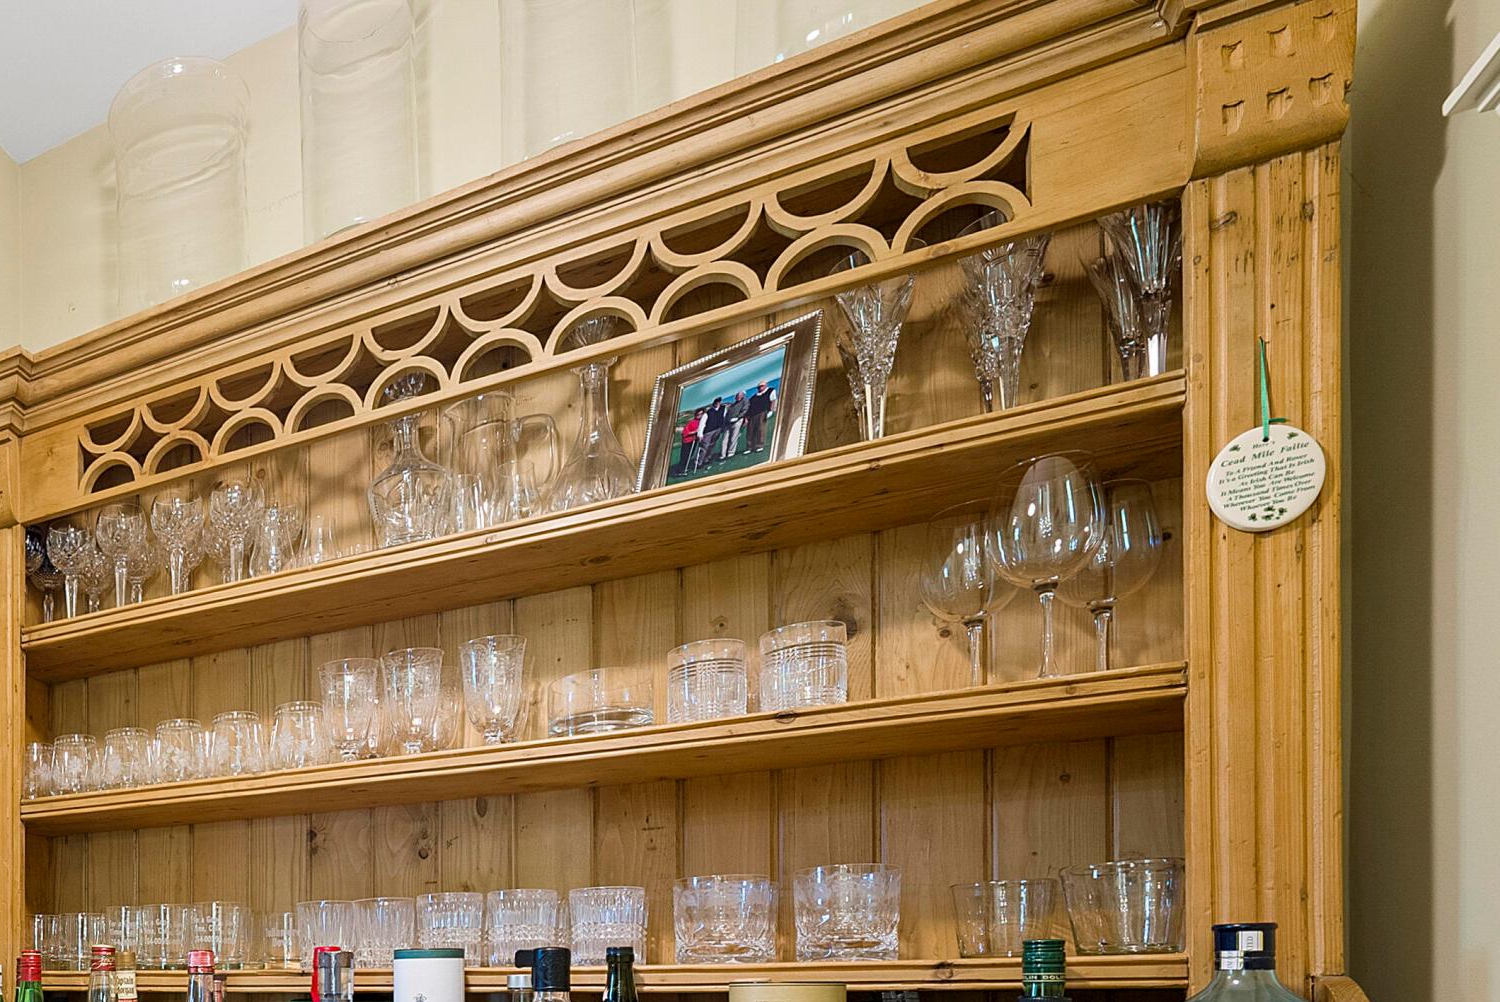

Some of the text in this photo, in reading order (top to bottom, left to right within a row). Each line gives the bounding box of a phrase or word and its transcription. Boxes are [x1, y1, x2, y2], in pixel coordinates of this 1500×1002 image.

[1220, 456, 1246, 467] Cead
[1251, 450, 1275, 461] Mile
[1238, 469, 1268, 480] Greeting
[1297, 458, 1315, 466] Irish
[1242, 463, 1267, 473] Friend
[1228, 487, 1251, 495] Means
[1283, 472, 1315, 482] Welcome
[1250, 476, 1267, 484] Irish
